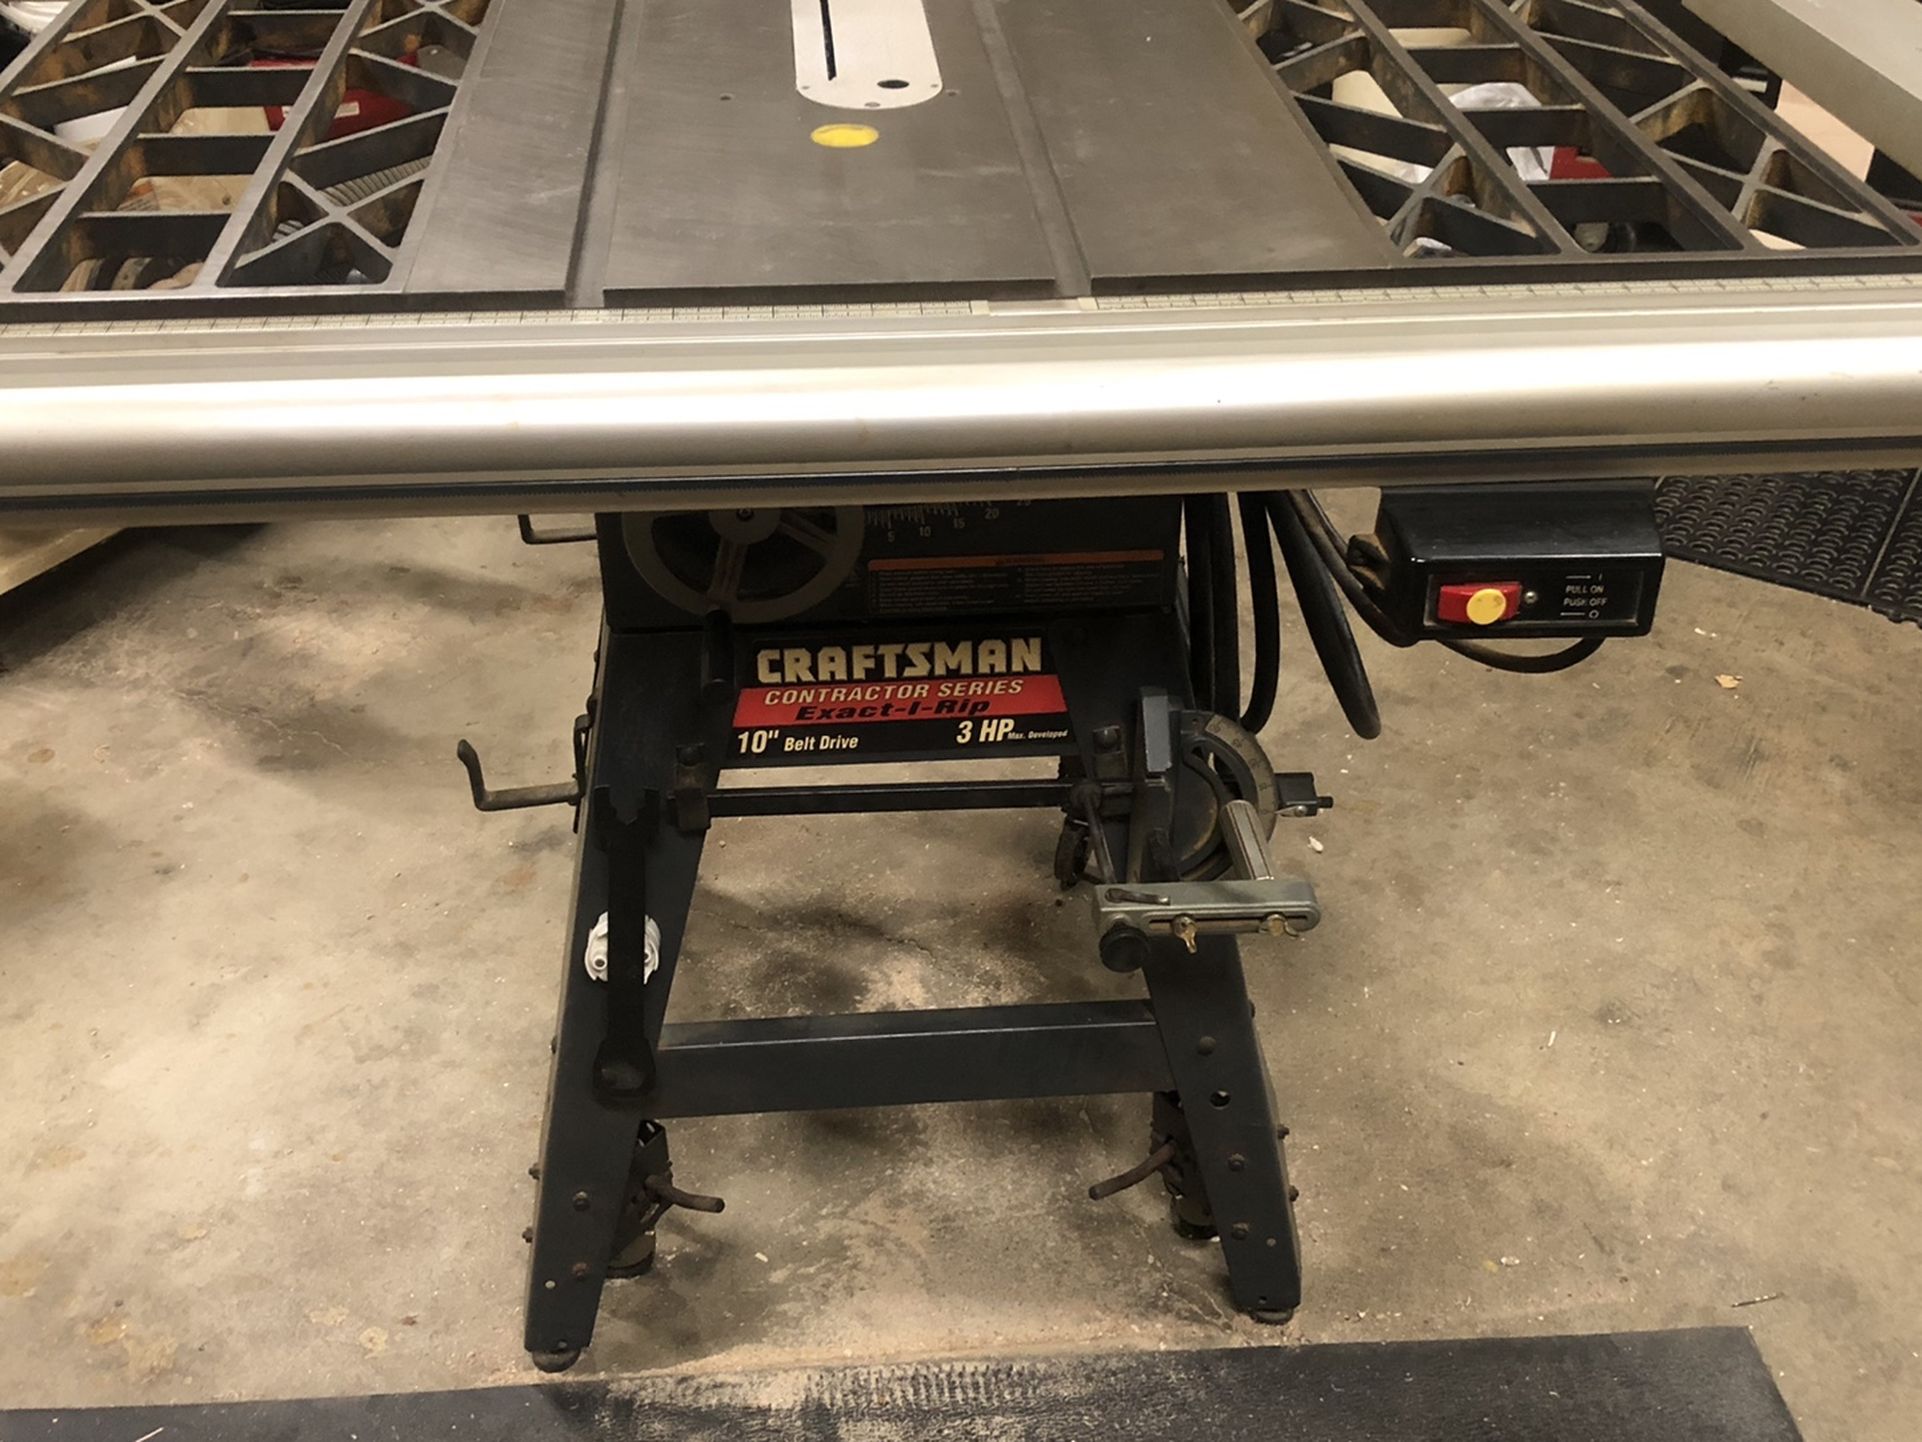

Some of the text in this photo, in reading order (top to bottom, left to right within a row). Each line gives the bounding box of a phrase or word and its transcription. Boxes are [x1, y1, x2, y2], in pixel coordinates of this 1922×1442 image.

[985, 508, 1000, 520] 20
[953, 518, 966, 530] 15
[887, 531, 896, 543] 5
[919, 526, 932, 537] 10
[1565, 584, 1604, 595] PULL ON
[1563, 597, 1607, 606] PUSH OFF
[756, 637, 1042, 684] CRAFTSMAN
[764, 679, 1024, 706] CONTRACTOR SERIES
[794, 699, 991, 722] Exact-I-Rip
[956, 720, 973, 744] 3
[978, 718, 1015, 742] HP
[1027, 728, 1068, 740] Developed
[737, 729, 859, 754] 10" Belt Drive
